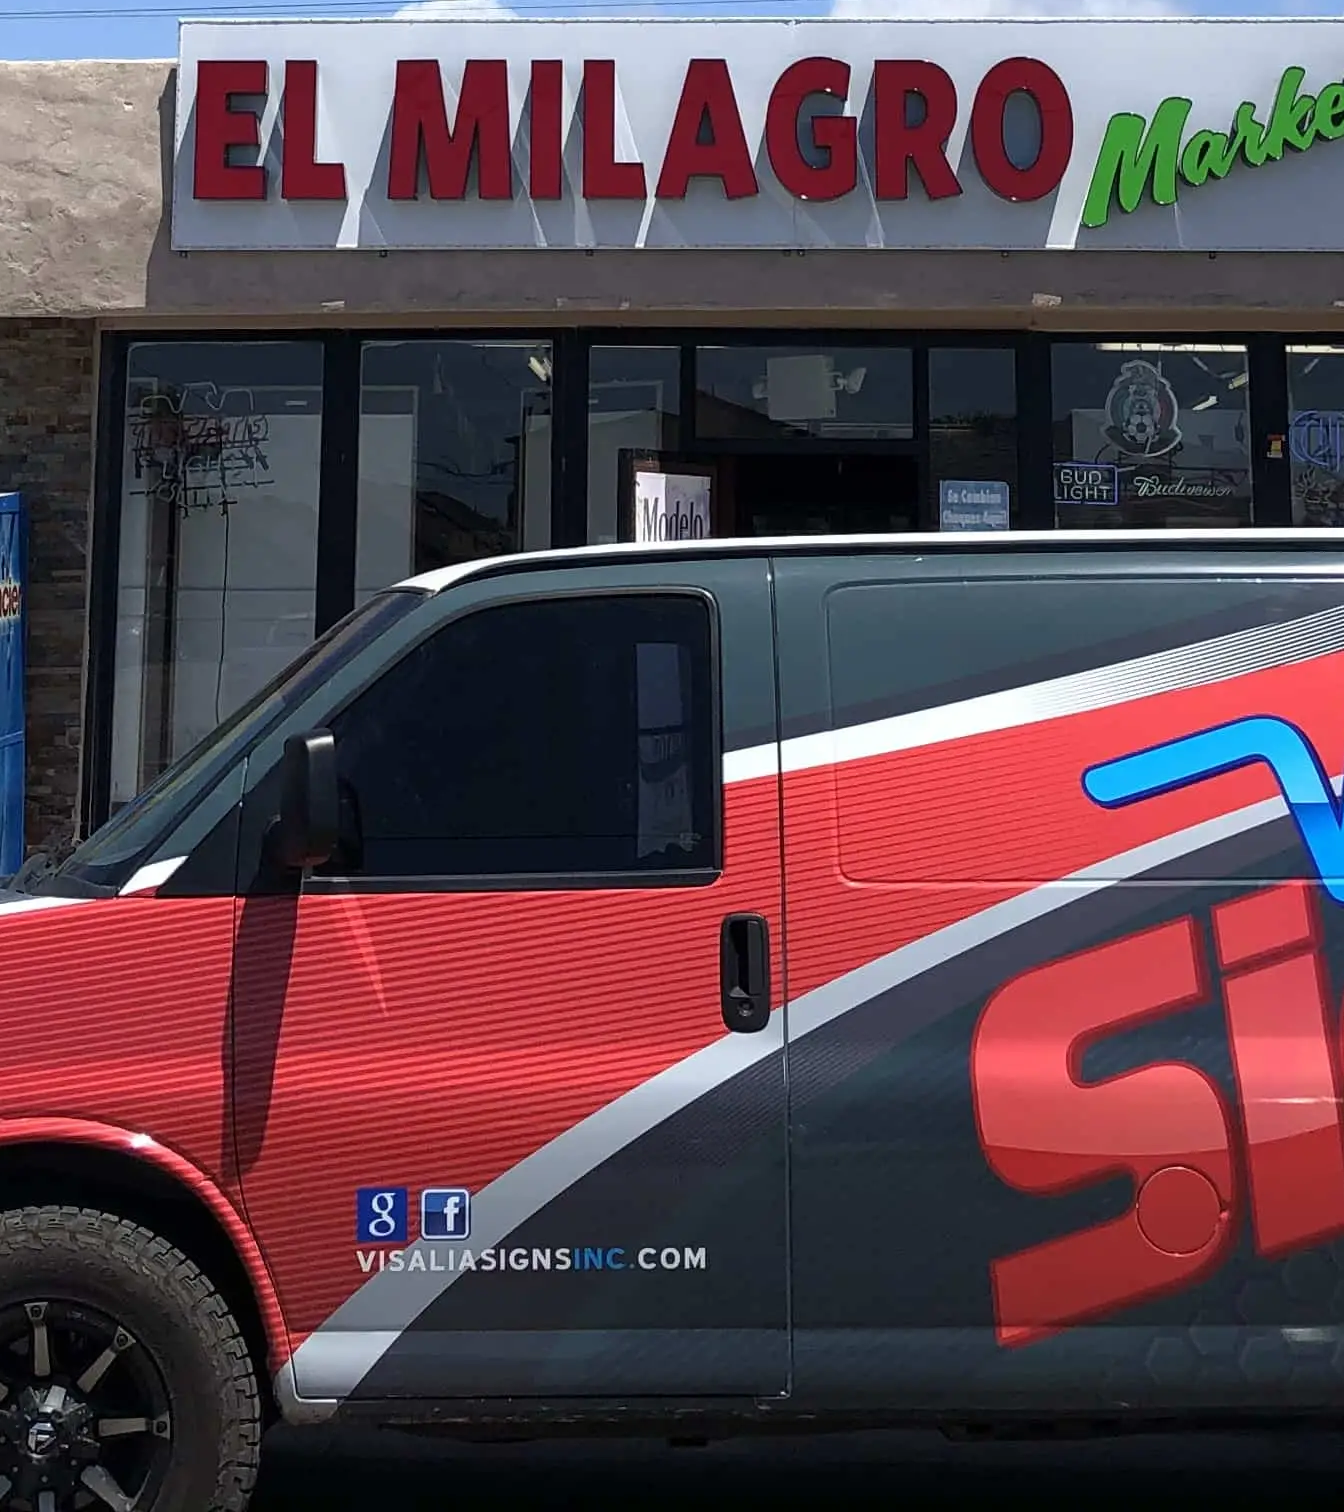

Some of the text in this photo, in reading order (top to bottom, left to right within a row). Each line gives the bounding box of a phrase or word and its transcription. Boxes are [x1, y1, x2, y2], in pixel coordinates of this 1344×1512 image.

[192, 58, 348, 202] EL
[386, 55, 1075, 204] MILAGRO
[1060, 469, 1102, 486] BUD
[1054, 485, 1113, 501] LIGHT
[642, 496, 704, 542] Modelo
[356, 1247, 707, 1272] VISALIASIGNSINC.COM
